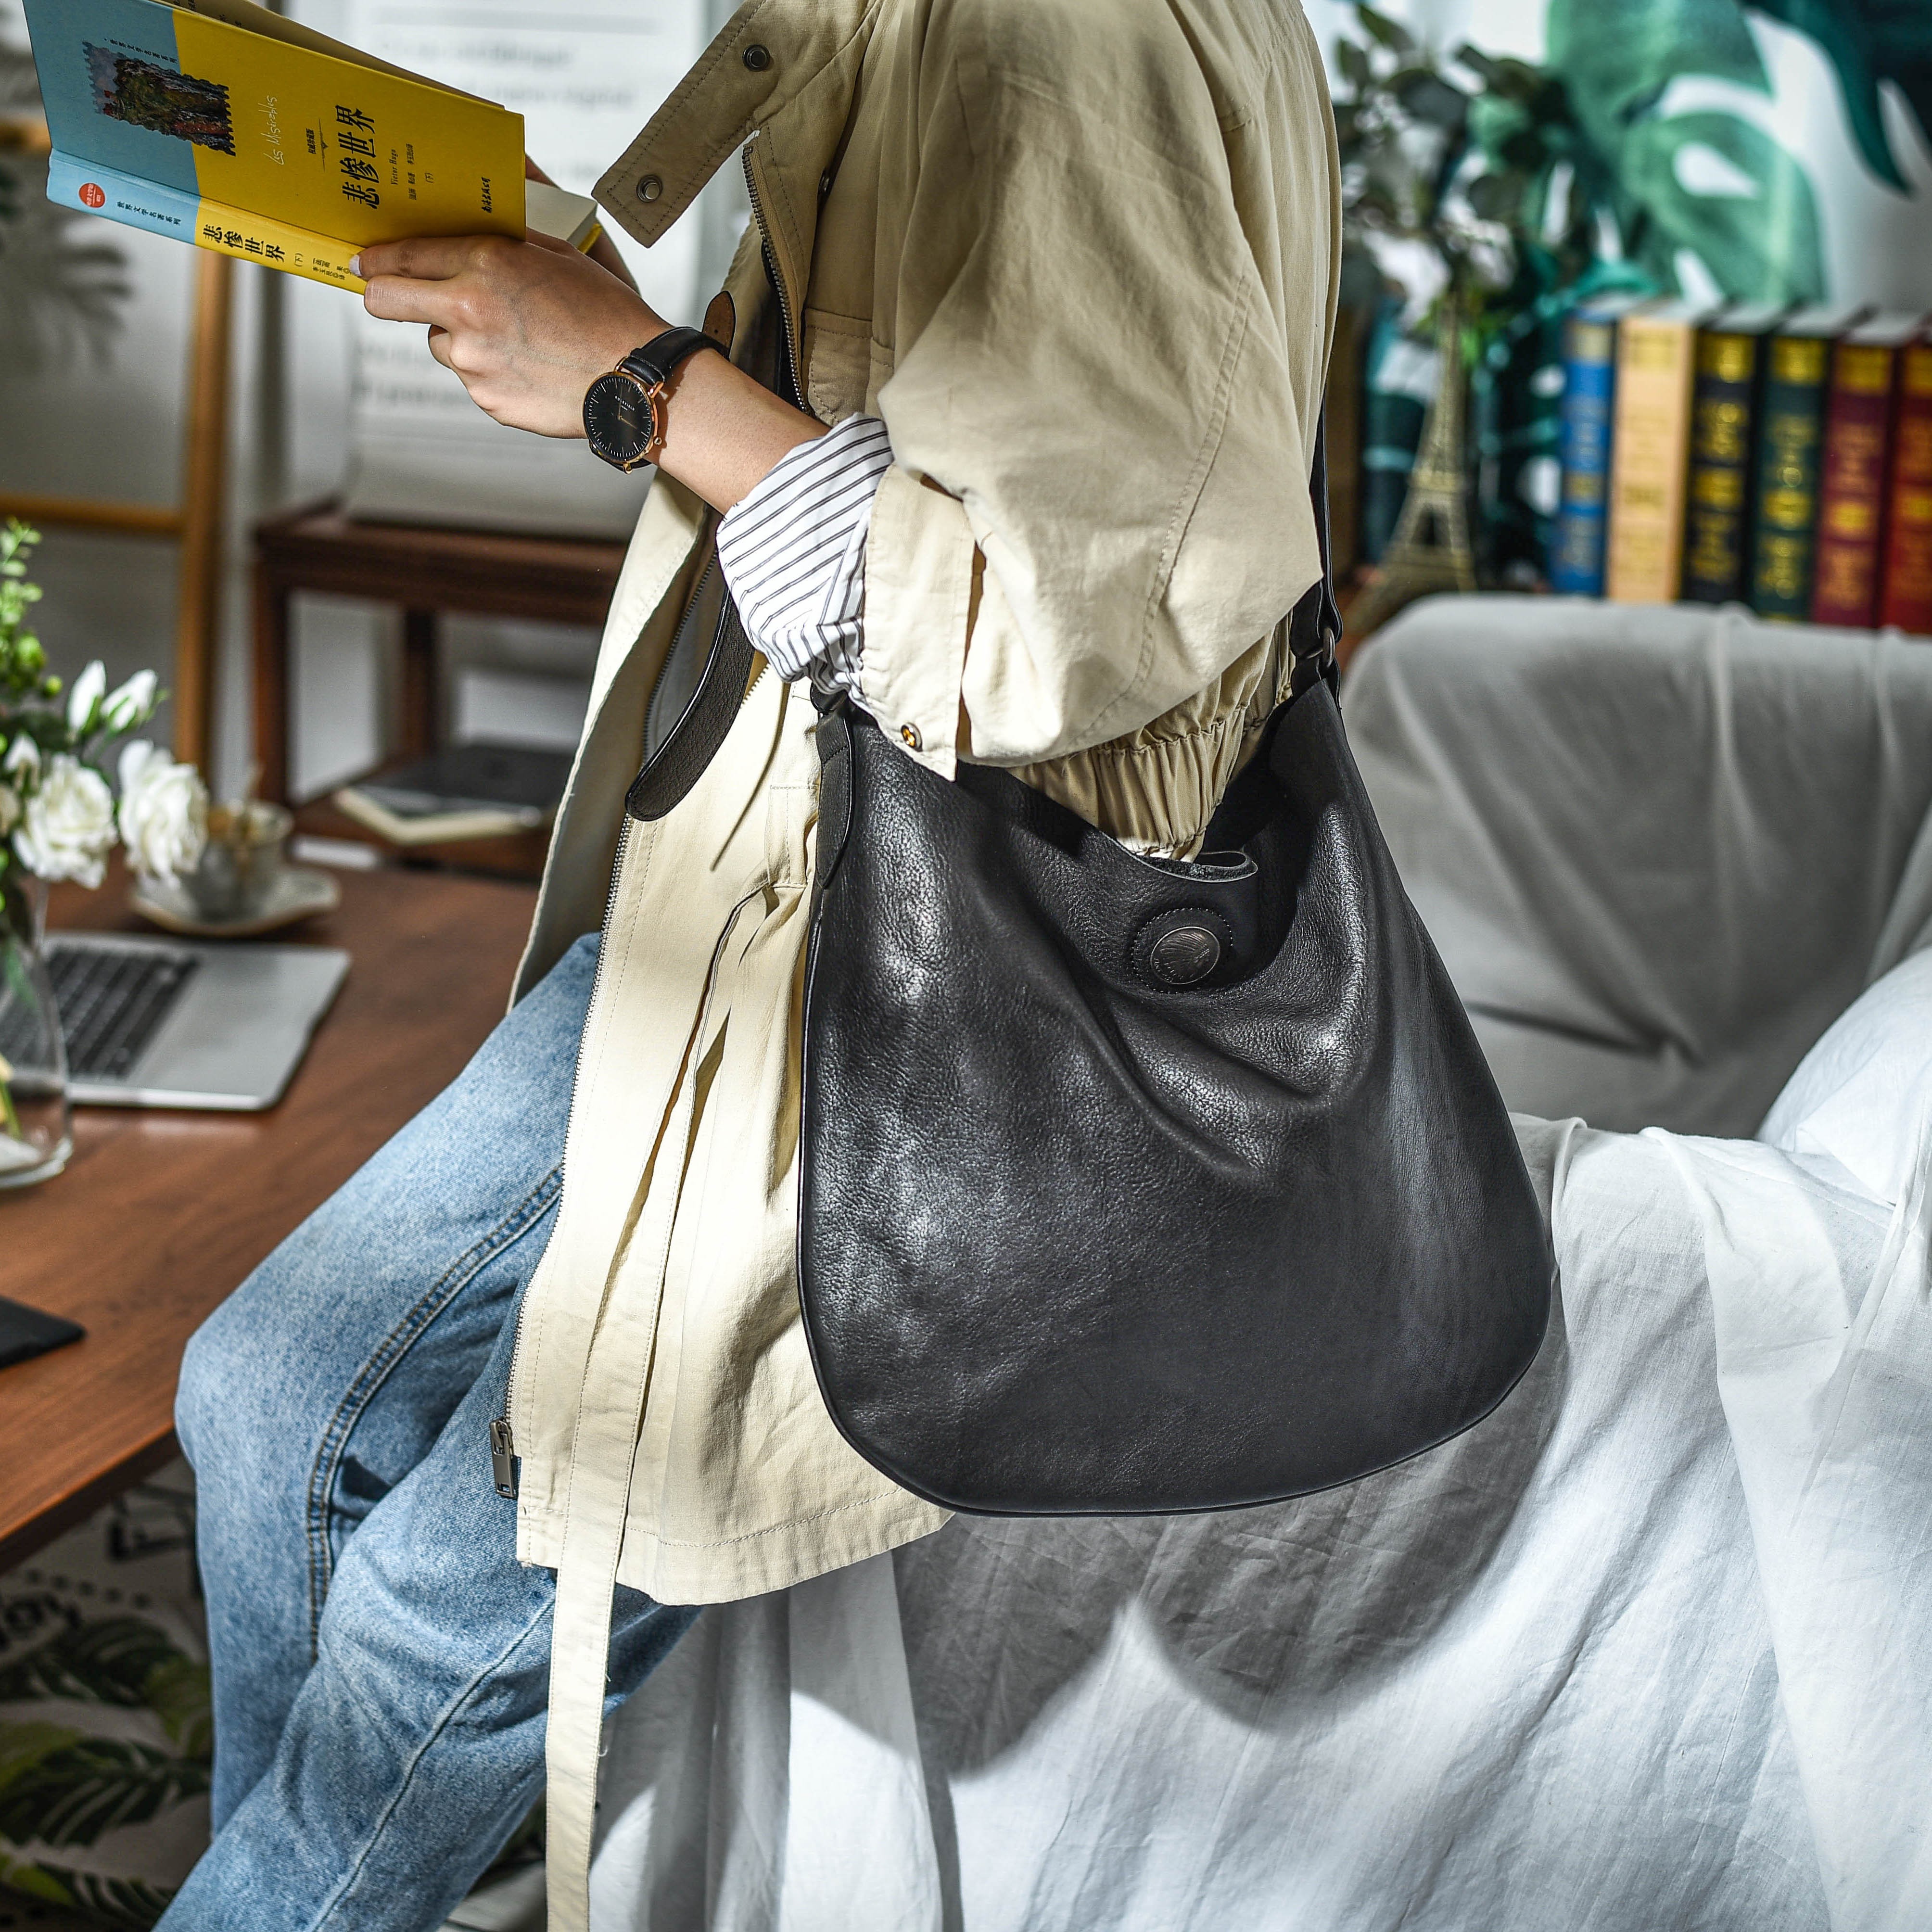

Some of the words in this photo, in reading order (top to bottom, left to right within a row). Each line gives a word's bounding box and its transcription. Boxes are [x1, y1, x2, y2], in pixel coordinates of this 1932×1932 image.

[263, 149, 284, 165] Les
[335, 104, 380, 209] 悲惨世界
[389, 149, 399, 165] Hugo
[390, 166, 399, 185] Victor
[203, 224, 286, 263] 悲惨世界
